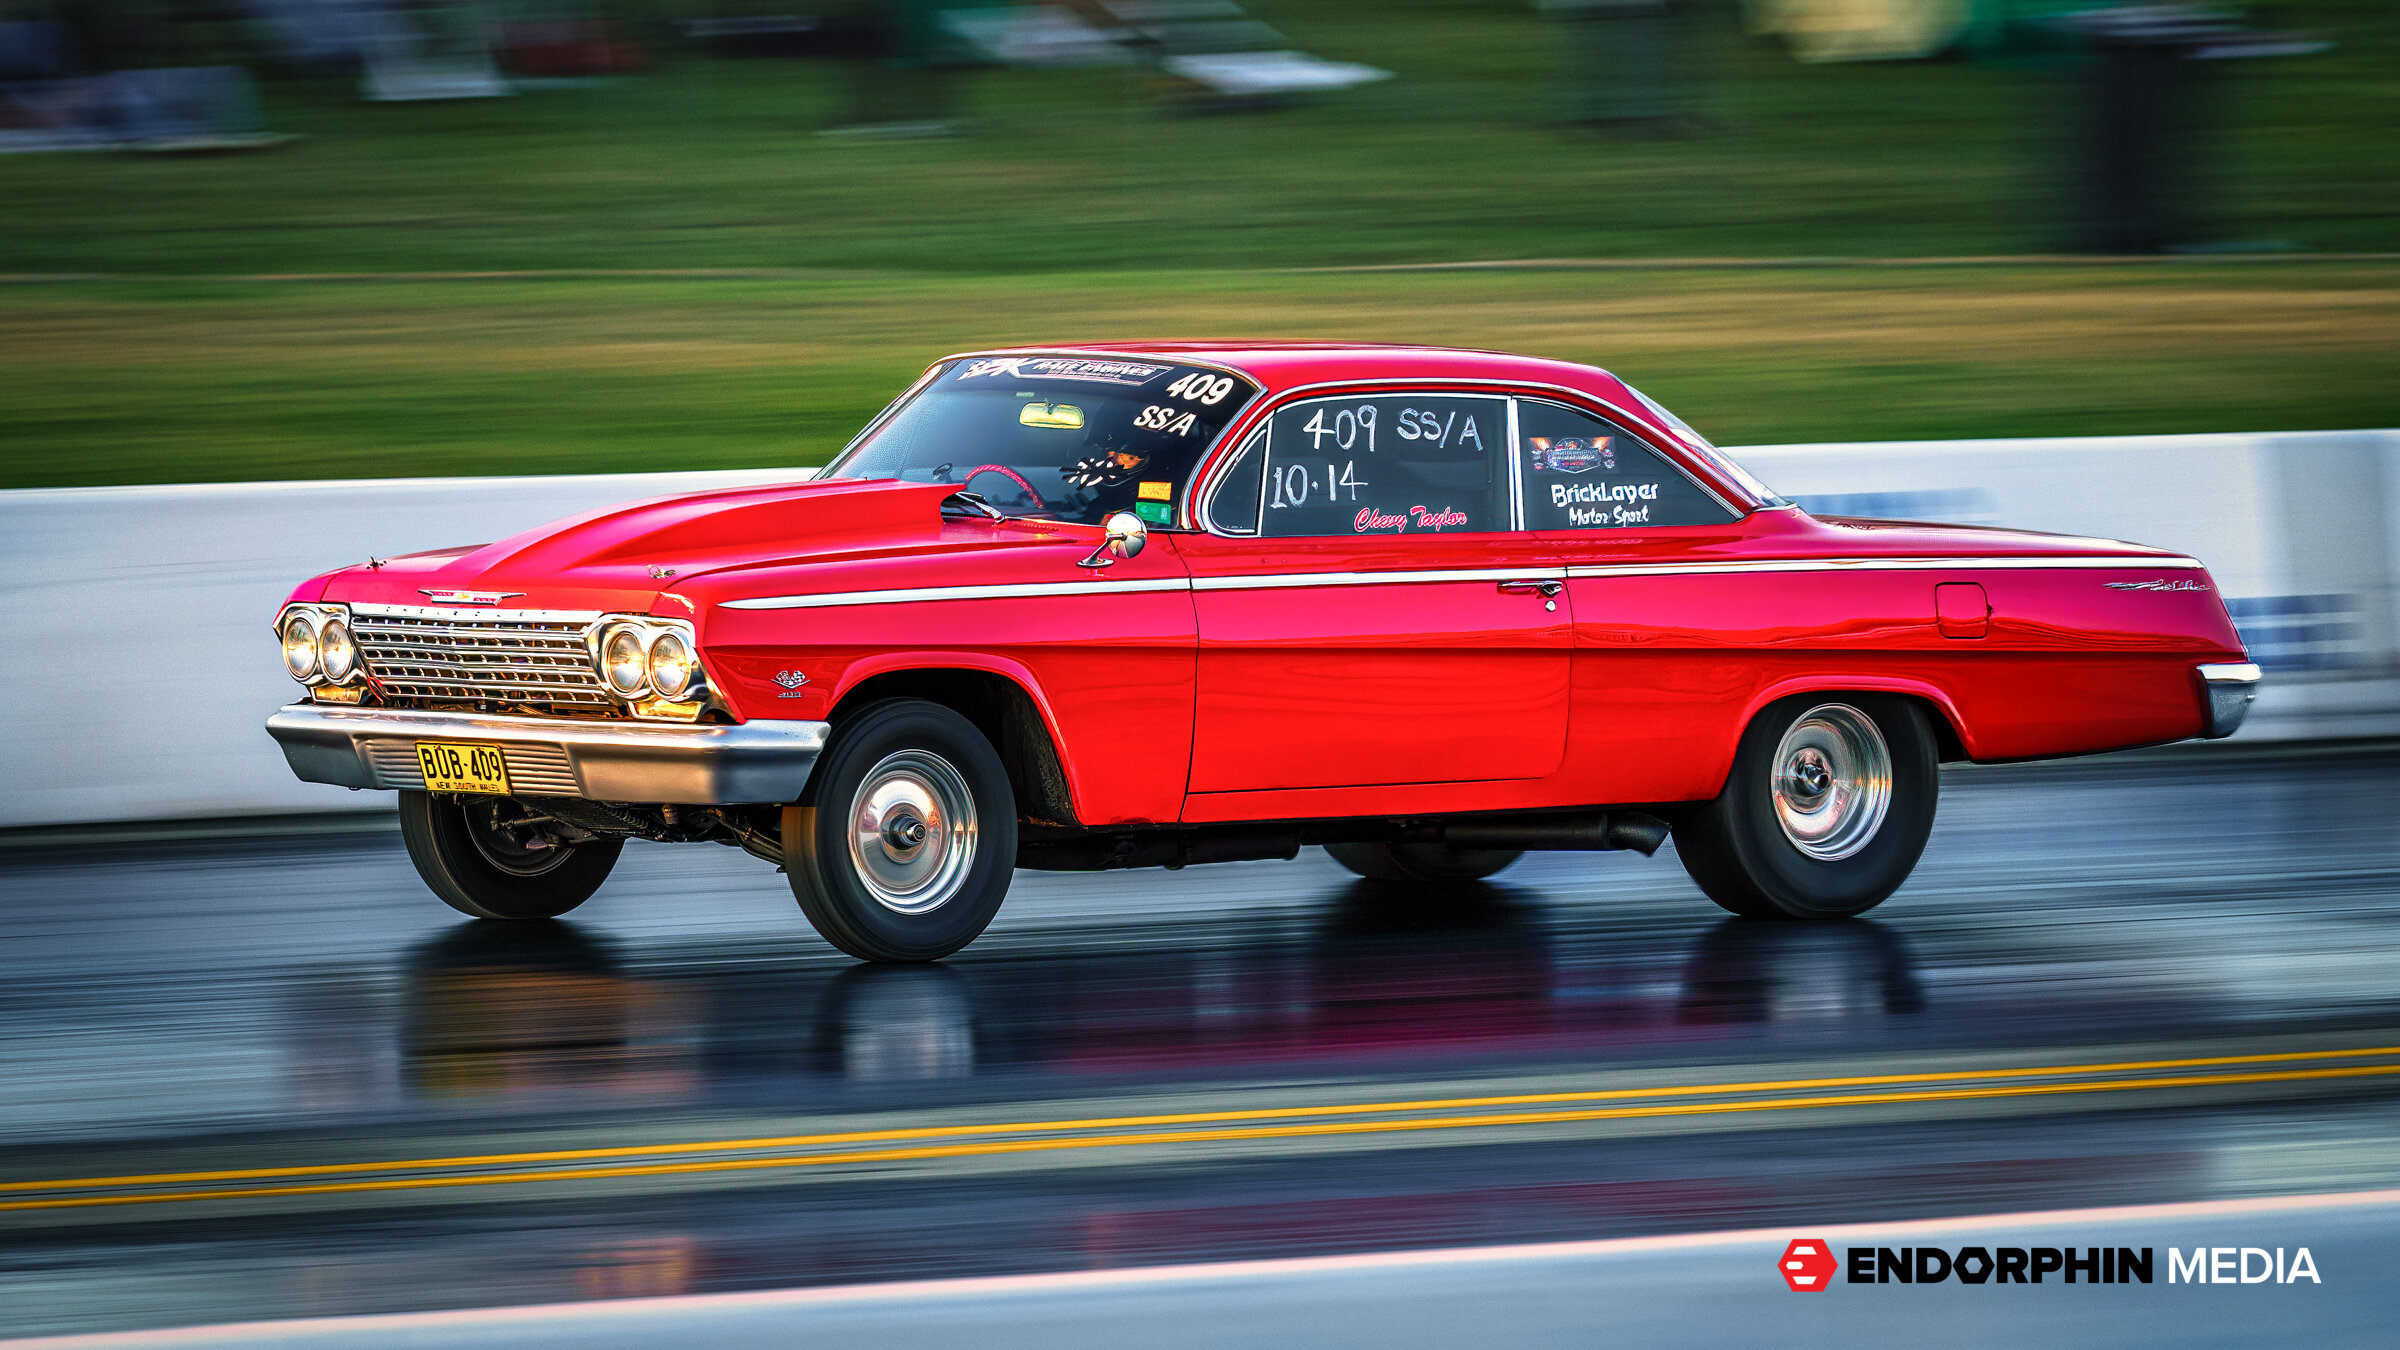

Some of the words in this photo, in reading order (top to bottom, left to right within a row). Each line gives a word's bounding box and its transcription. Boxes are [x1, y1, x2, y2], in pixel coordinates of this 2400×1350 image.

[1165, 373, 1234, 406] 409
[1133, 405, 1197, 437] SS/A
[1302, 404, 1378, 452] 409
[1396, 407, 1484, 451] SS/A
[1353, 506, 1408, 534] Chevy
[1410, 505, 1468, 532] Taylor
[1568, 506, 1609, 527] Motor
[1612, 504, 1650, 528] Sport
